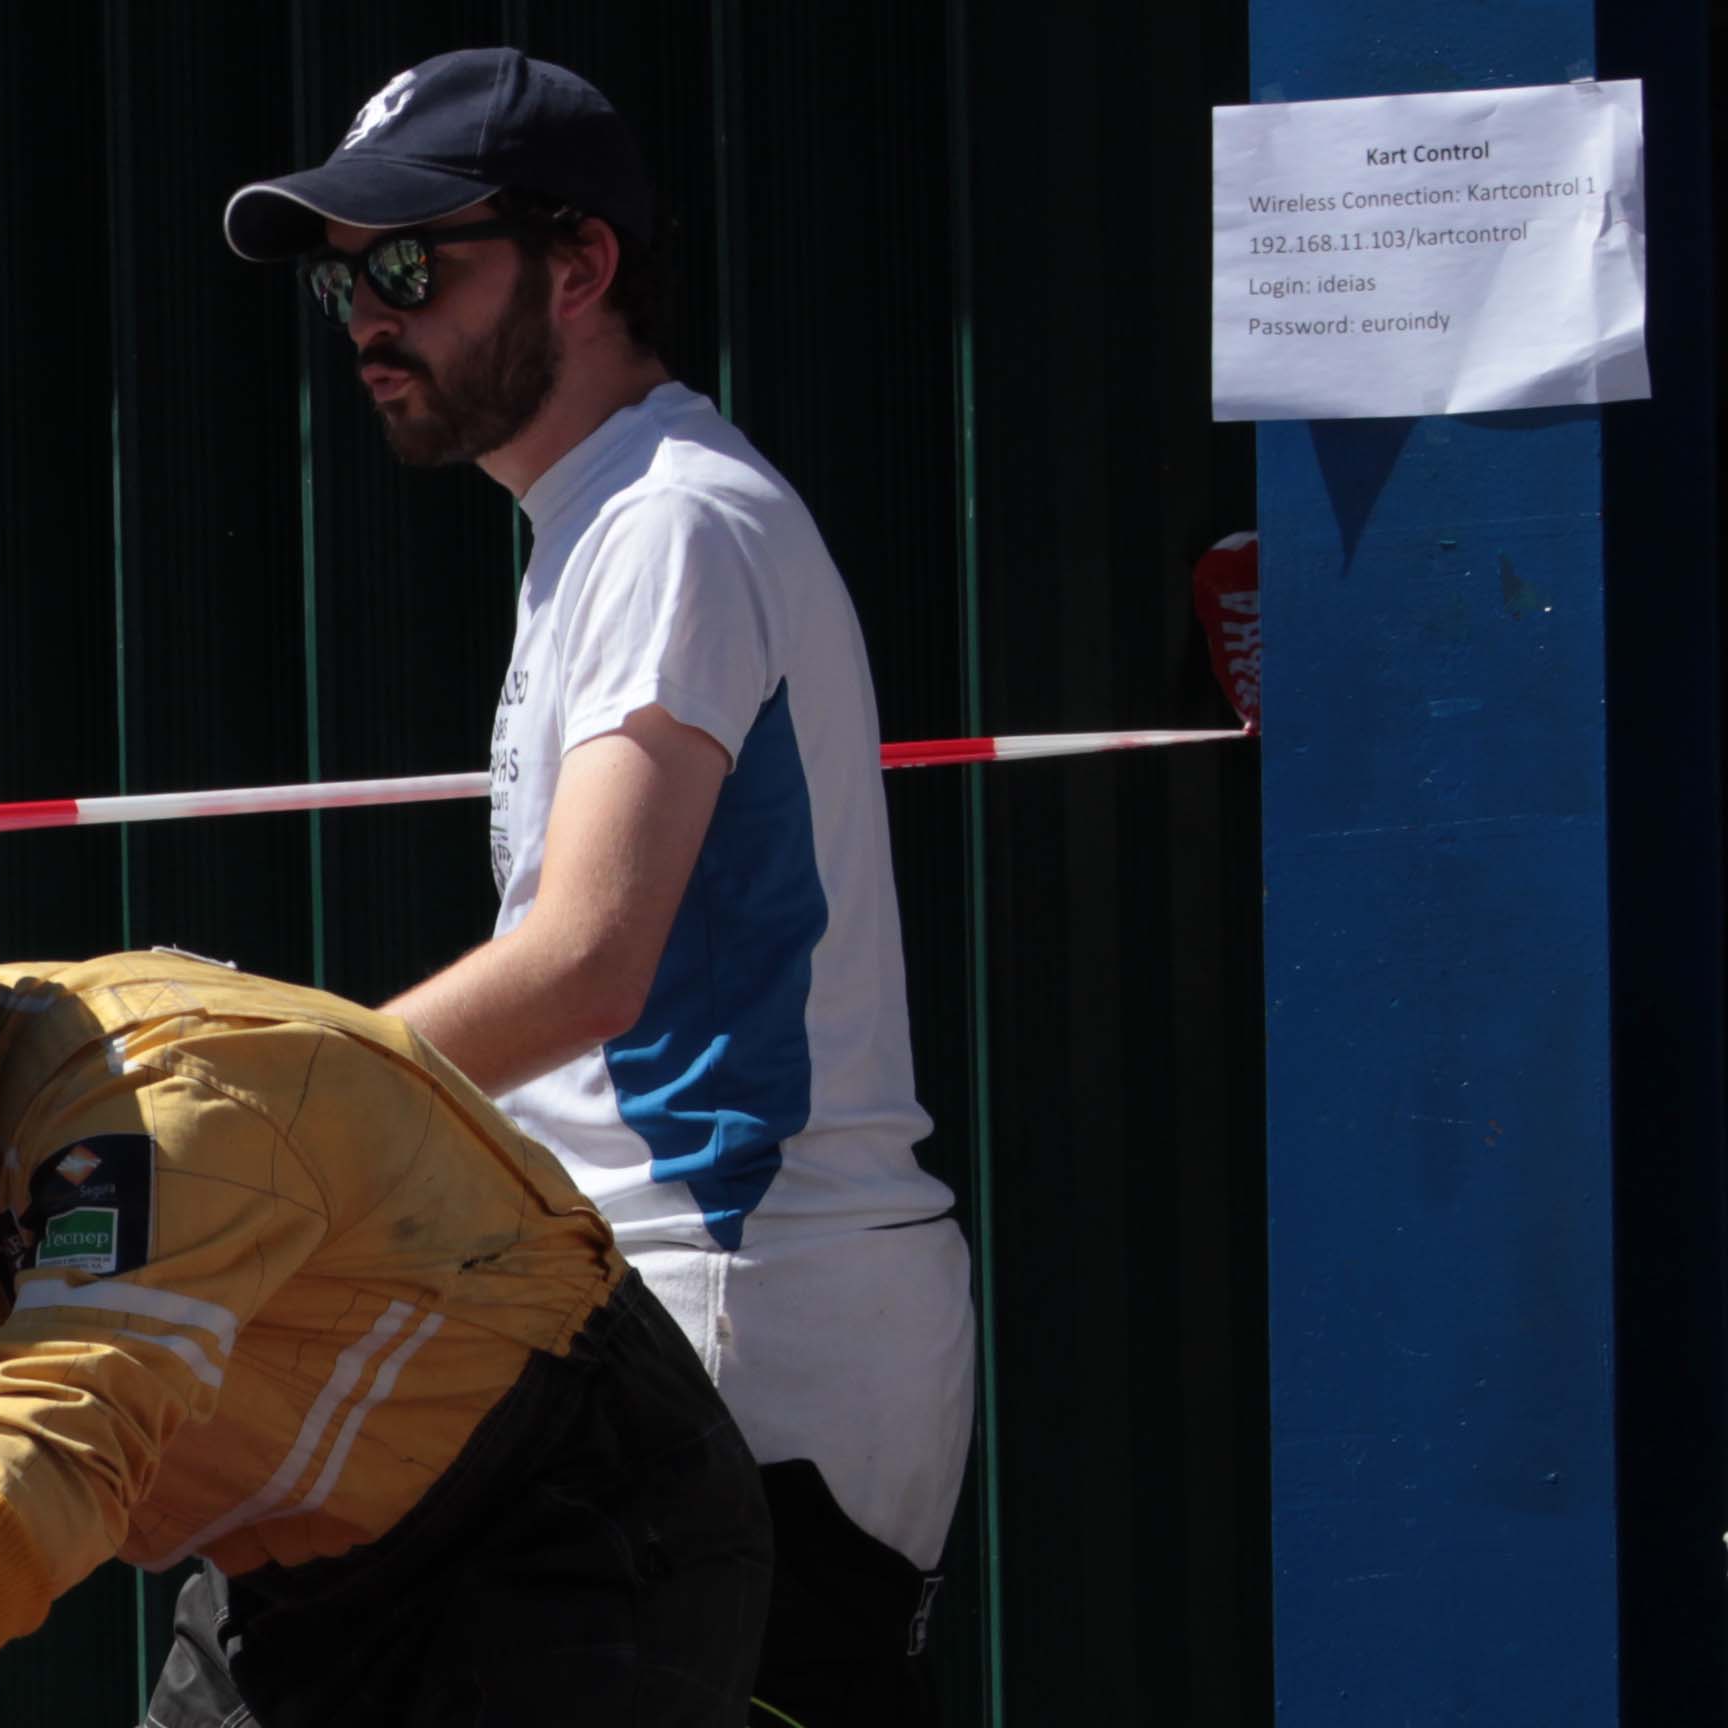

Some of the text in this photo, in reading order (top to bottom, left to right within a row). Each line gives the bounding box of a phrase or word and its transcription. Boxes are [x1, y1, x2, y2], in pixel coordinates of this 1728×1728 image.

[1365, 141, 1491, 166] Kart Control
[1248, 176, 1596, 214] Wireless Connection: Kartcontrol 1
[1249, 222, 1528, 255] 192.168.11.103/kartcontrol
[1248, 272, 1377, 300] Login: ideias
[1248, 311, 1451, 337] Password: euroindy
